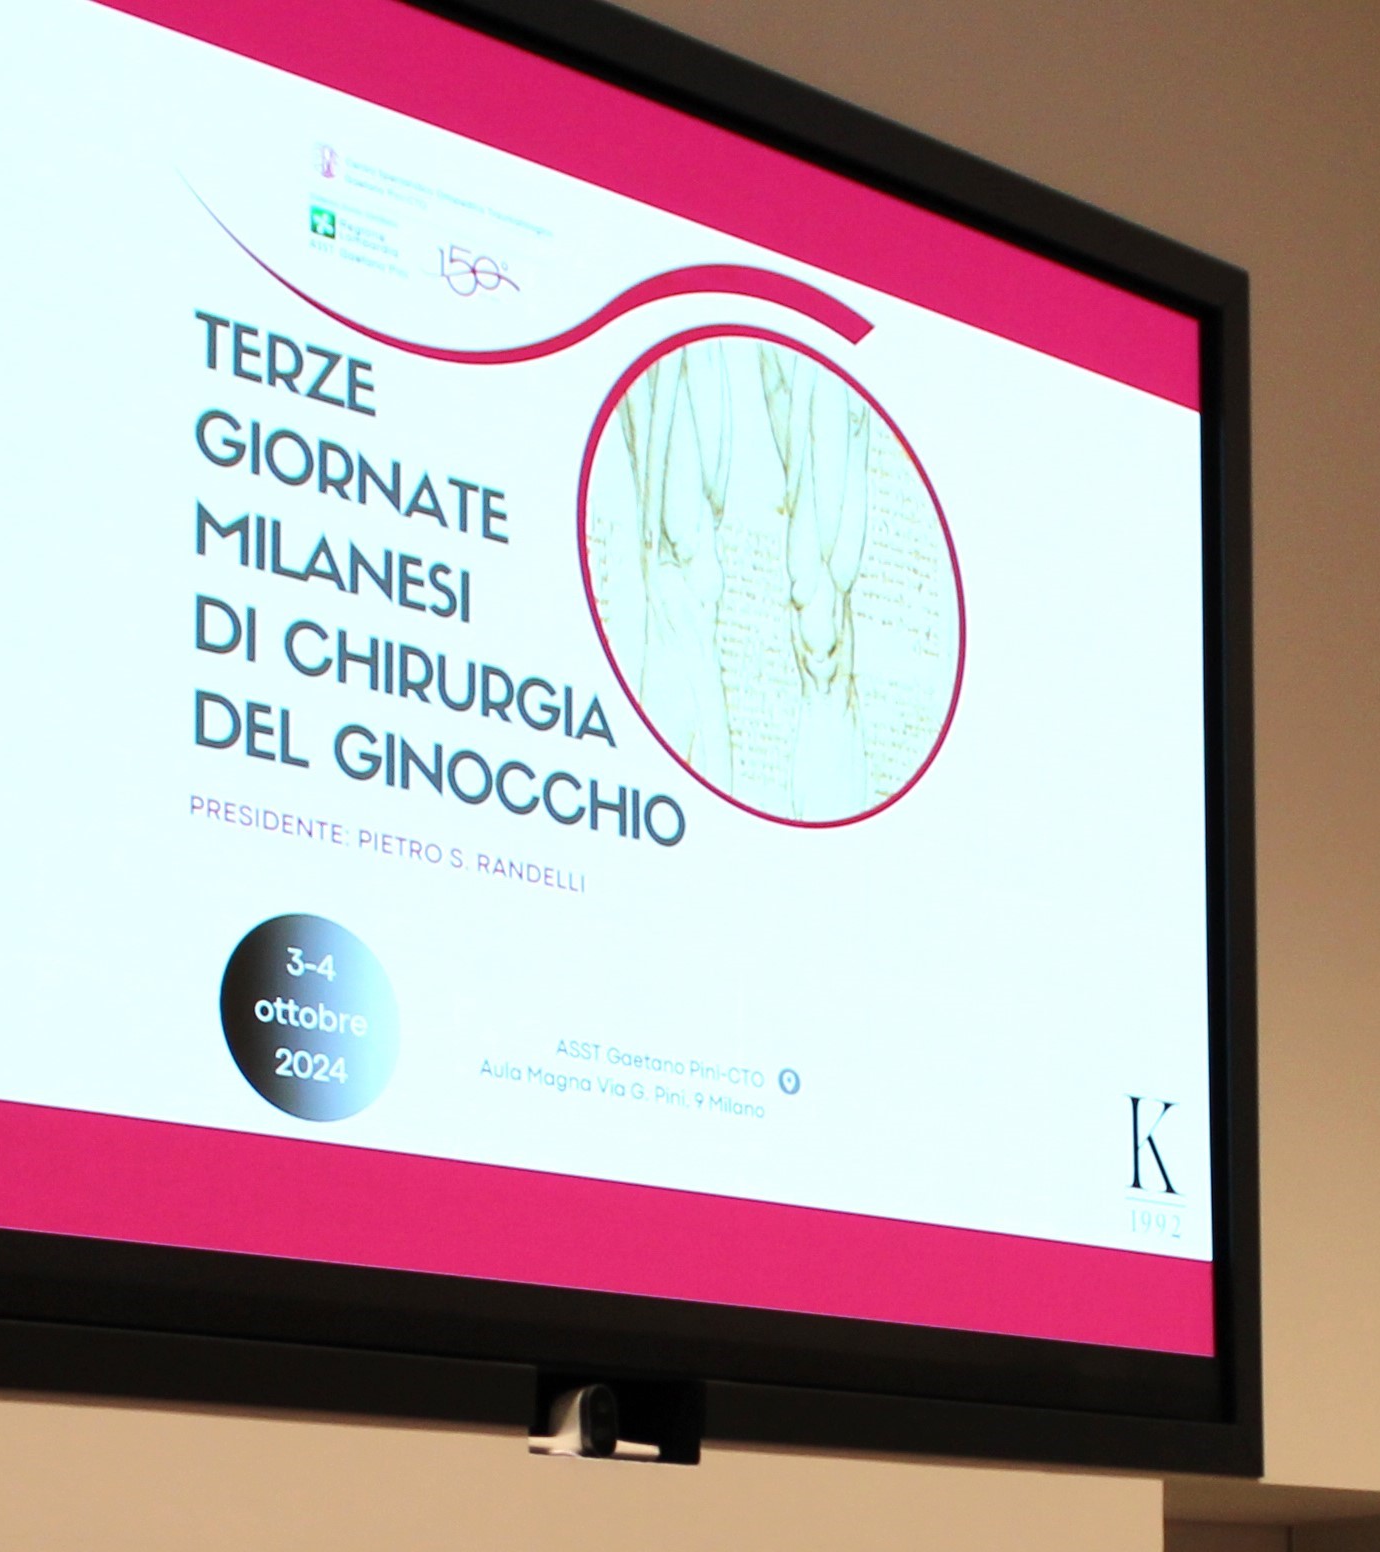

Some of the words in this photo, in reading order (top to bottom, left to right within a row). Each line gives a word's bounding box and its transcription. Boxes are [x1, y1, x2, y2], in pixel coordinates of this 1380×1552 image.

[195, 309, 376, 416] TERZE
[195, 409, 508, 544] GIORNATE
[196, 499, 469, 623] MILANESI
[195, 594, 256, 662] DI
[284, 620, 616, 748] CHIRURGIA
[195, 690, 309, 768] DEL
[334, 725, 686, 847] GINOCCHIO
[190, 796, 350, 846] PRESIDENTE:
[359, 830, 443, 864] PIETRO
[450, 849, 470, 871] S.
[478, 855, 585, 893] RANDELLI
[286, 946, 337, 982] 3-4
[254, 997, 368, 1036] ottobre
[275, 1048, 348, 1084] 2024
[556, 1040, 600, 1062] ASST
[607, 1047, 684, 1075] Gaetano
[690, 1060, 765, 1088] Pini-CTO
[480, 1059, 521, 1081] Aula
[527, 1066, 591, 1092] Magna
[597, 1077, 625, 1097] Via
[631, 1083, 649, 1100] G.
[710, 1097, 765, 1118] Milano
[1125, 1094, 1184, 1196] K
